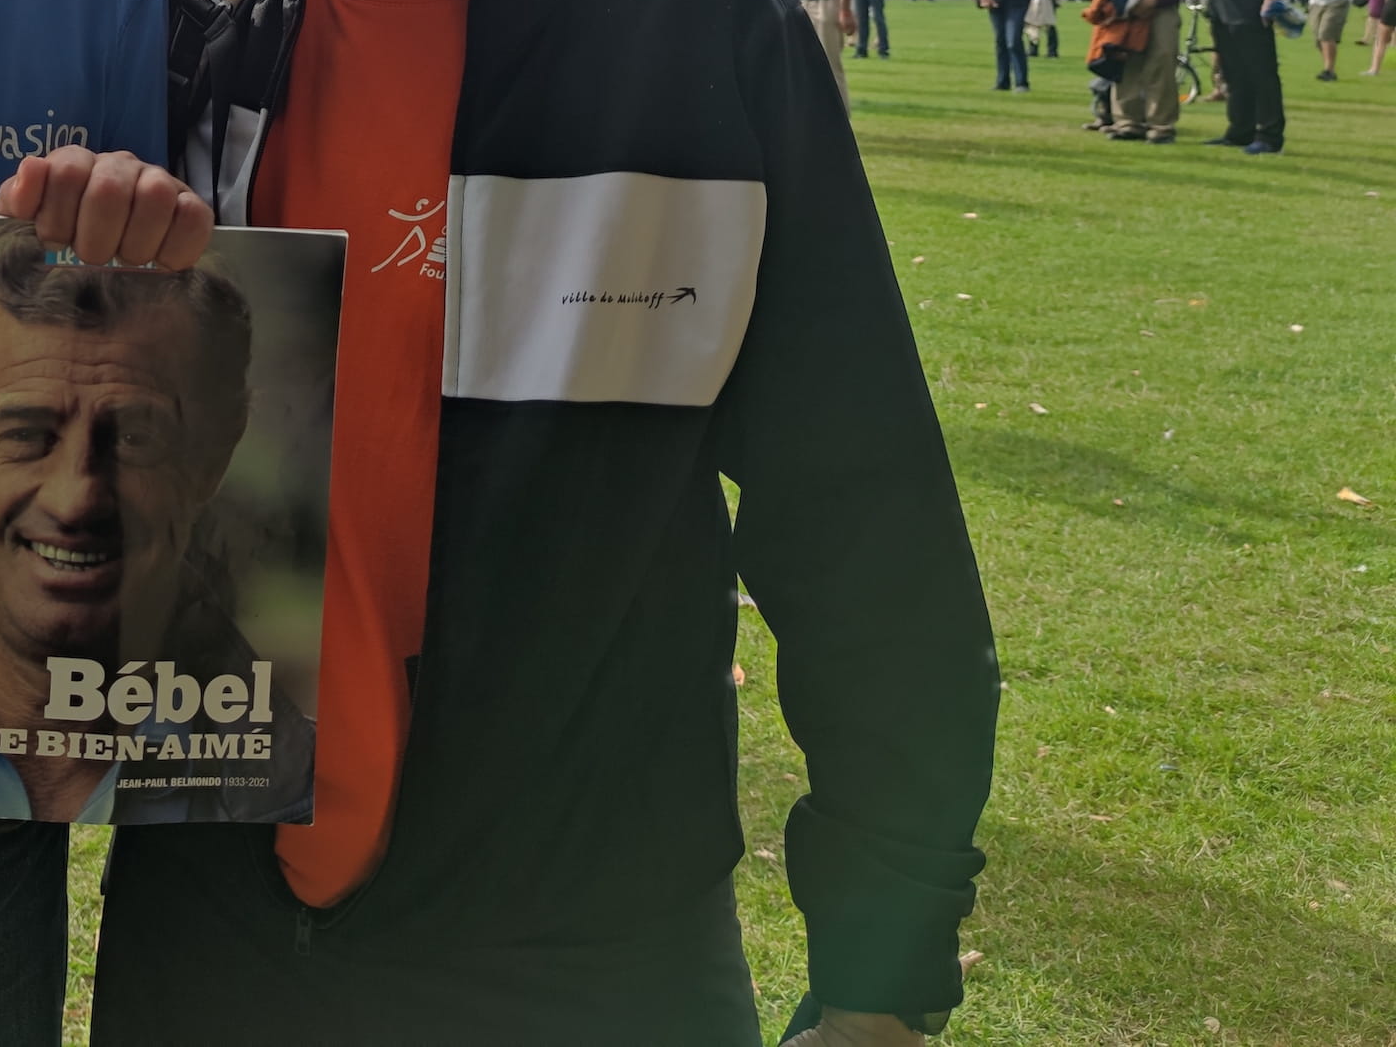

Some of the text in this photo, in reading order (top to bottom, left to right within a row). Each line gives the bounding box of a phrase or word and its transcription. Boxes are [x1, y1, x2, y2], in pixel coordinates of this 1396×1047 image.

[419, 262, 447, 281] Fou
[43, 655, 273, 726] Bébel
[35, 727, 272, 762] BIEN-AIMÉ
[116, 776, 271, 789] JEAN-PAUL BELMONDO 1933-2021
